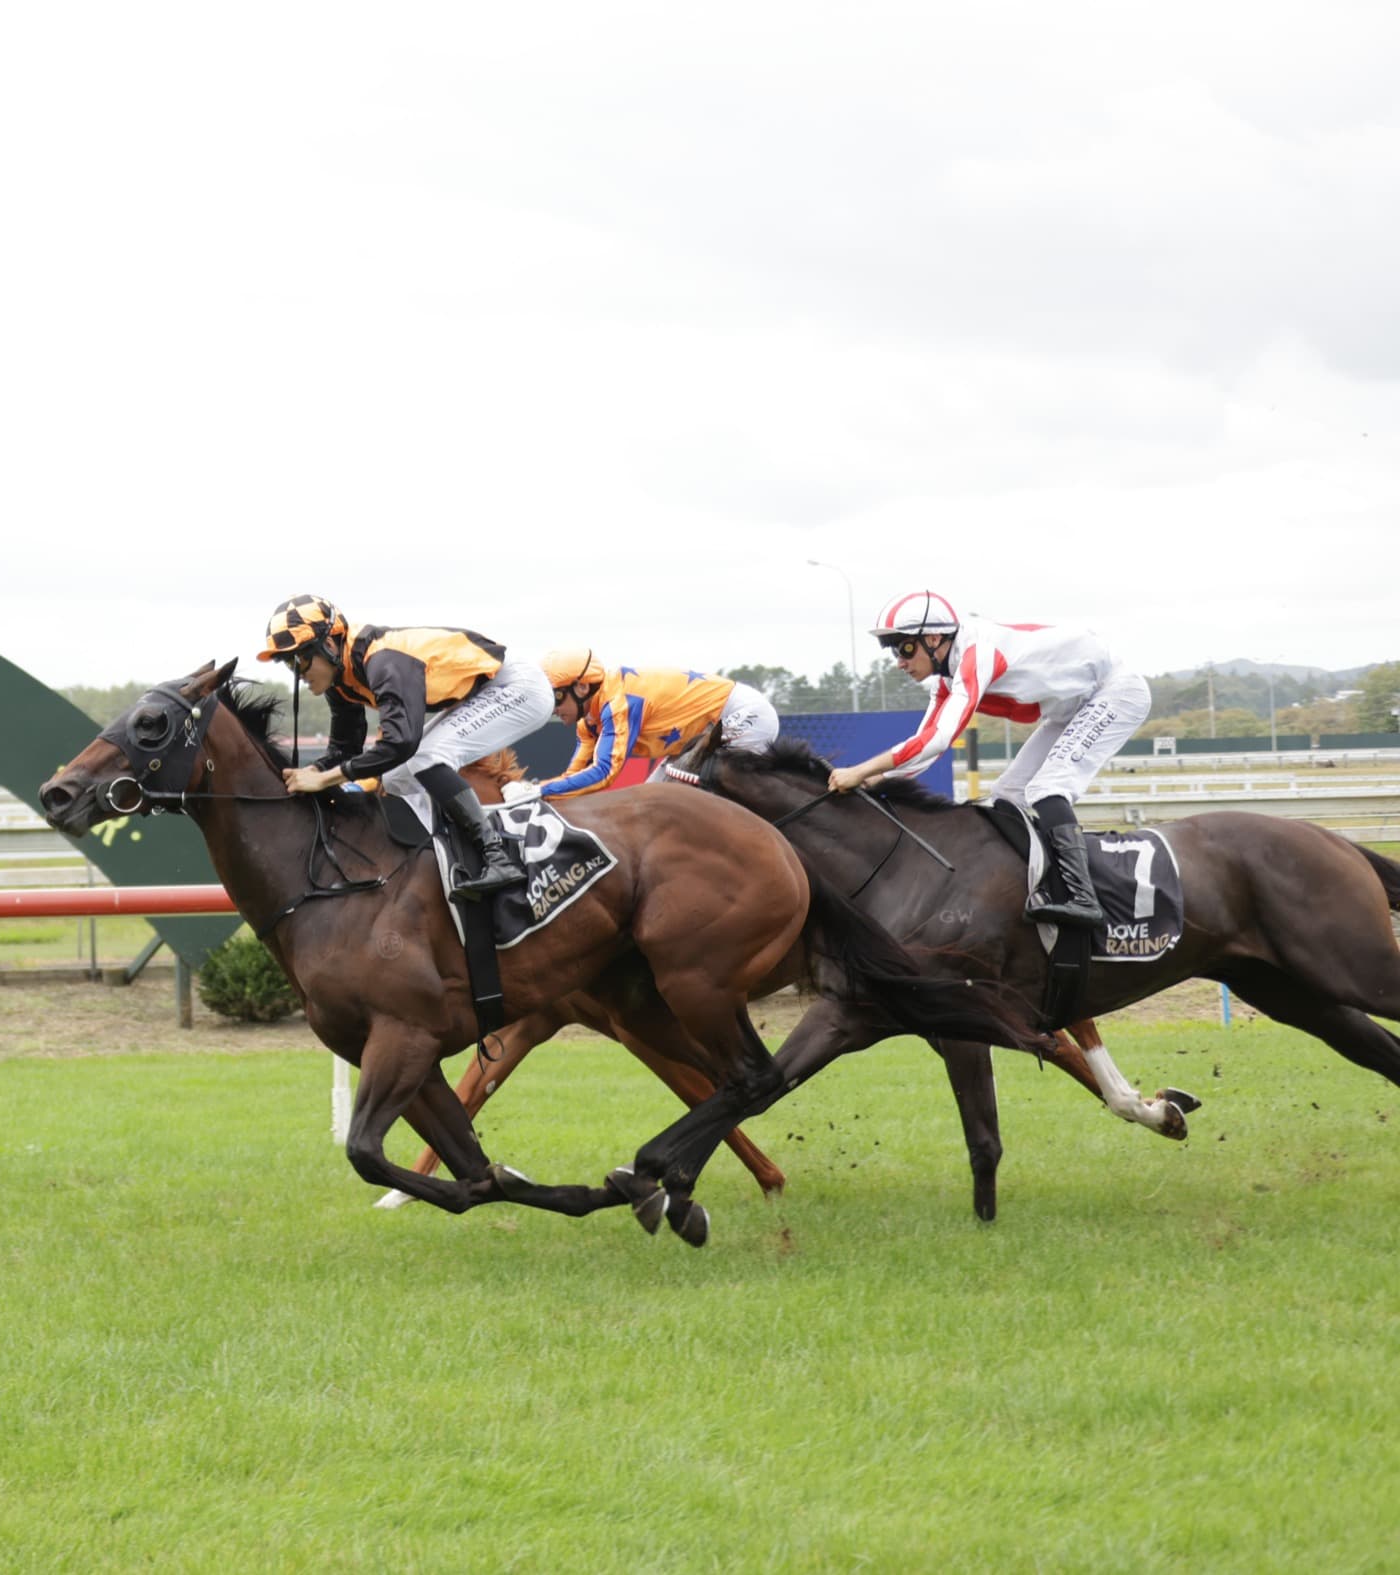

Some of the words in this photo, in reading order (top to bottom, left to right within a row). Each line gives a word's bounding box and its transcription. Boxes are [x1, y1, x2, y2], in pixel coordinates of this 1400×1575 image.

[1081, 709, 1118, 750] BERGE
[526, 864, 560, 907] LOVE
[1100, 840, 1155, 919] 7
[1107, 922, 1149, 939] LOVE
